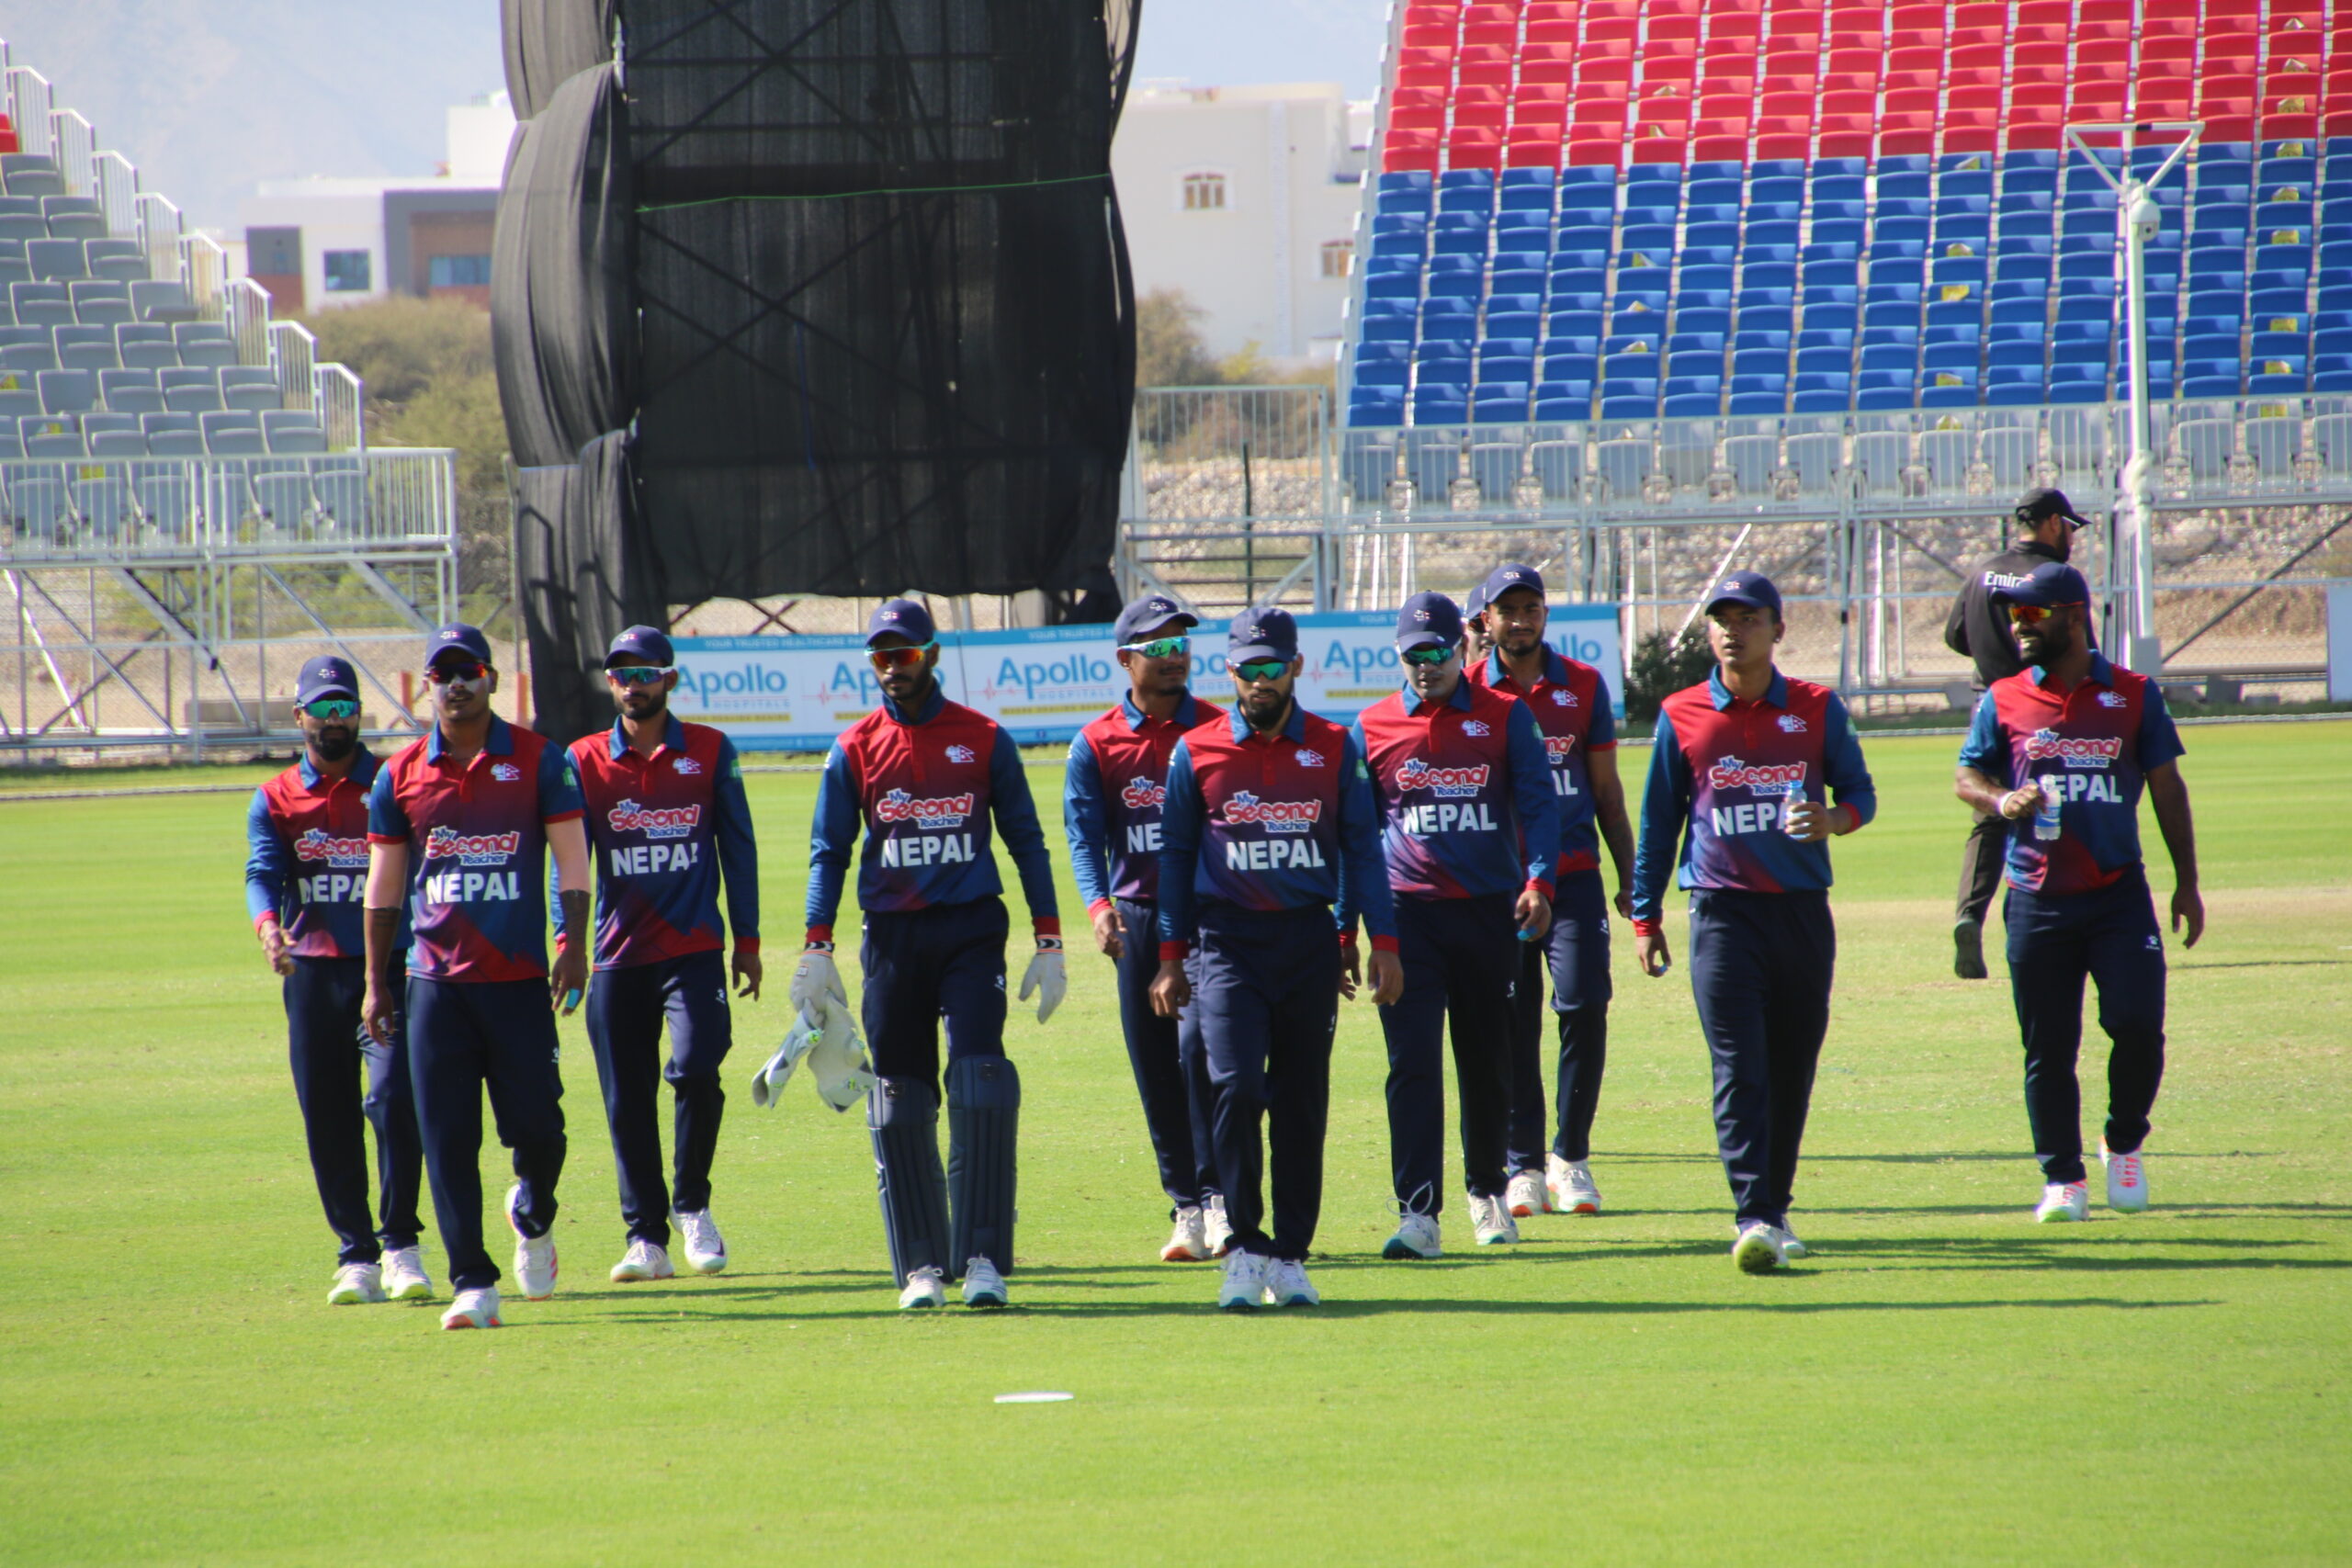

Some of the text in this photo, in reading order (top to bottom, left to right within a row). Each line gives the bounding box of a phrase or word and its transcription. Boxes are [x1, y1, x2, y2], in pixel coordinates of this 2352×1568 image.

[1984, 570, 2021, 588] Emir
[705, 638, 733, 649] YOUR
[736, 637, 778, 648] TRUSTED
[1029, 630, 1057, 640] YOUR
[1555, 633, 1602, 662] llo
[1324, 638, 1399, 683] Apo
[673, 662, 787, 708] Apollo
[997, 654, 1112, 701] Apollo
[2036, 728, 2059, 742] My
[2025, 737, 2122, 761] Second
[1405, 758, 1428, 773] My
[1720, 756, 1744, 771] My
[2065, 757, 2110, 768] Teacher
[1131, 776, 1154, 790] My
[1396, 764, 1490, 791] Second
[1709, 761, 1807, 790] Second
[887, 788, 911, 803] My
[1122, 785, 1166, 808] Sec
[1234, 790, 1259, 806] My
[1434, 785, 1478, 797] Teacher
[1751, 784, 1790, 796] Teach
[2052, 774, 2123, 804] EPAL
[617, 799, 640, 814] My
[877, 793, 974, 822] Second
[1223, 799, 1322, 825] Second
[608, 804, 700, 831] Second
[917, 817, 963, 829] Teacher
[1265, 819, 1309, 832] Teacher
[1403, 804, 1498, 834] NEPAL
[1712, 803, 1787, 837] NEP
[304, 829, 327, 843] My
[432, 826, 457, 840] My
[646, 826, 690, 839] Teacher
[426, 831, 520, 859] Second
[881, 833, 976, 868] NEPAL
[329, 854, 370, 867] Teache
[459, 853, 507, 865] Teacher
[1227, 839, 1326, 871] NEPAL
[298, 874, 368, 905] NEPA
[426, 872, 520, 905] NEPAL
